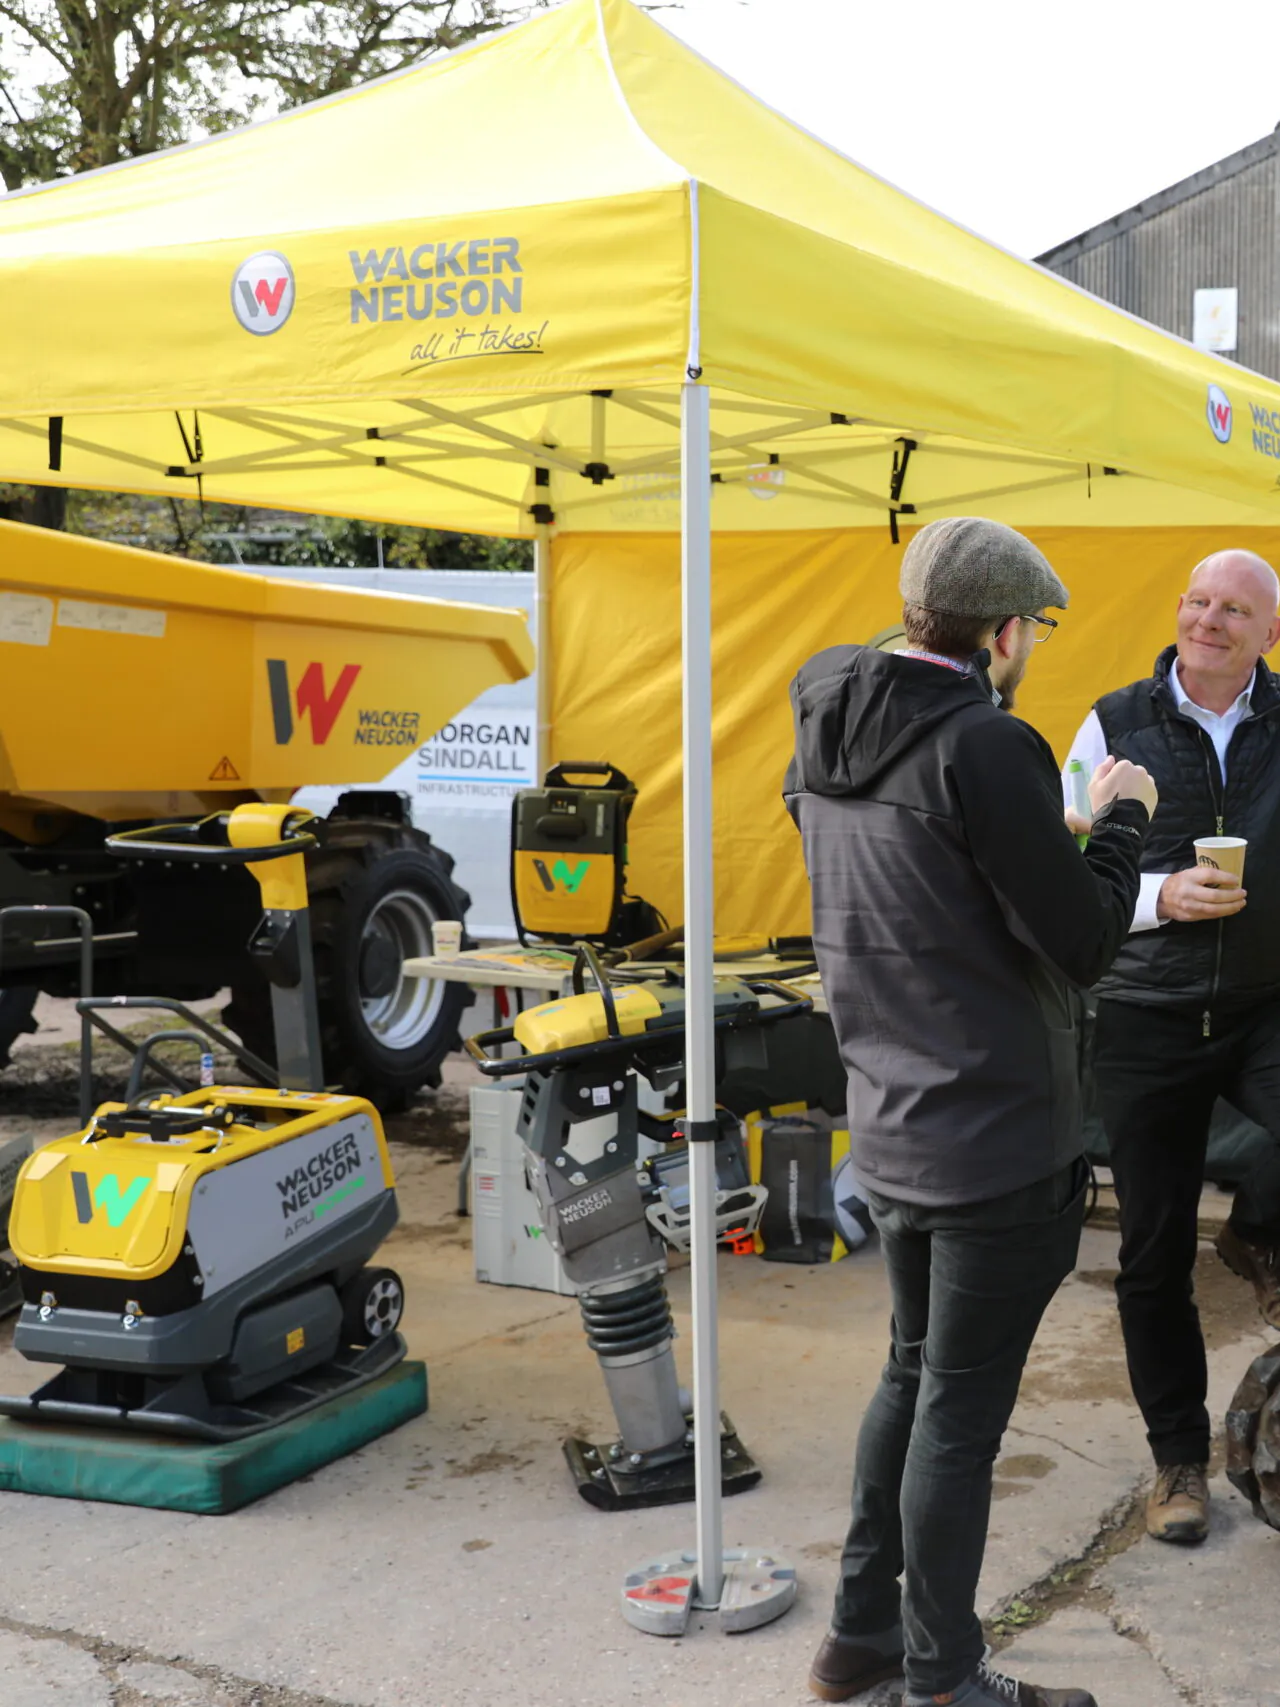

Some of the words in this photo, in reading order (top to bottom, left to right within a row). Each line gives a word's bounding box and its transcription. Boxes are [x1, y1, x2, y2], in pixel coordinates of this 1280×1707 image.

[348, 236, 523, 284] WACKER
[350, 277, 523, 324] NEUSON
[410, 332, 444, 361] all
[449, 327, 475, 355] it
[479, 320, 549, 351] takes!
[357, 709, 420, 728] WACKER
[354, 728, 419, 746] NEUSON
[433, 723, 530, 746] ORGAN
[417, 747, 527, 771] SINDALL
[276, 1132, 357, 1196] WACKER
[282, 1150, 361, 1219] NEUSON
[559, 1189, 610, 1217] WACKER
[563, 1195, 613, 1225] NEUSON
